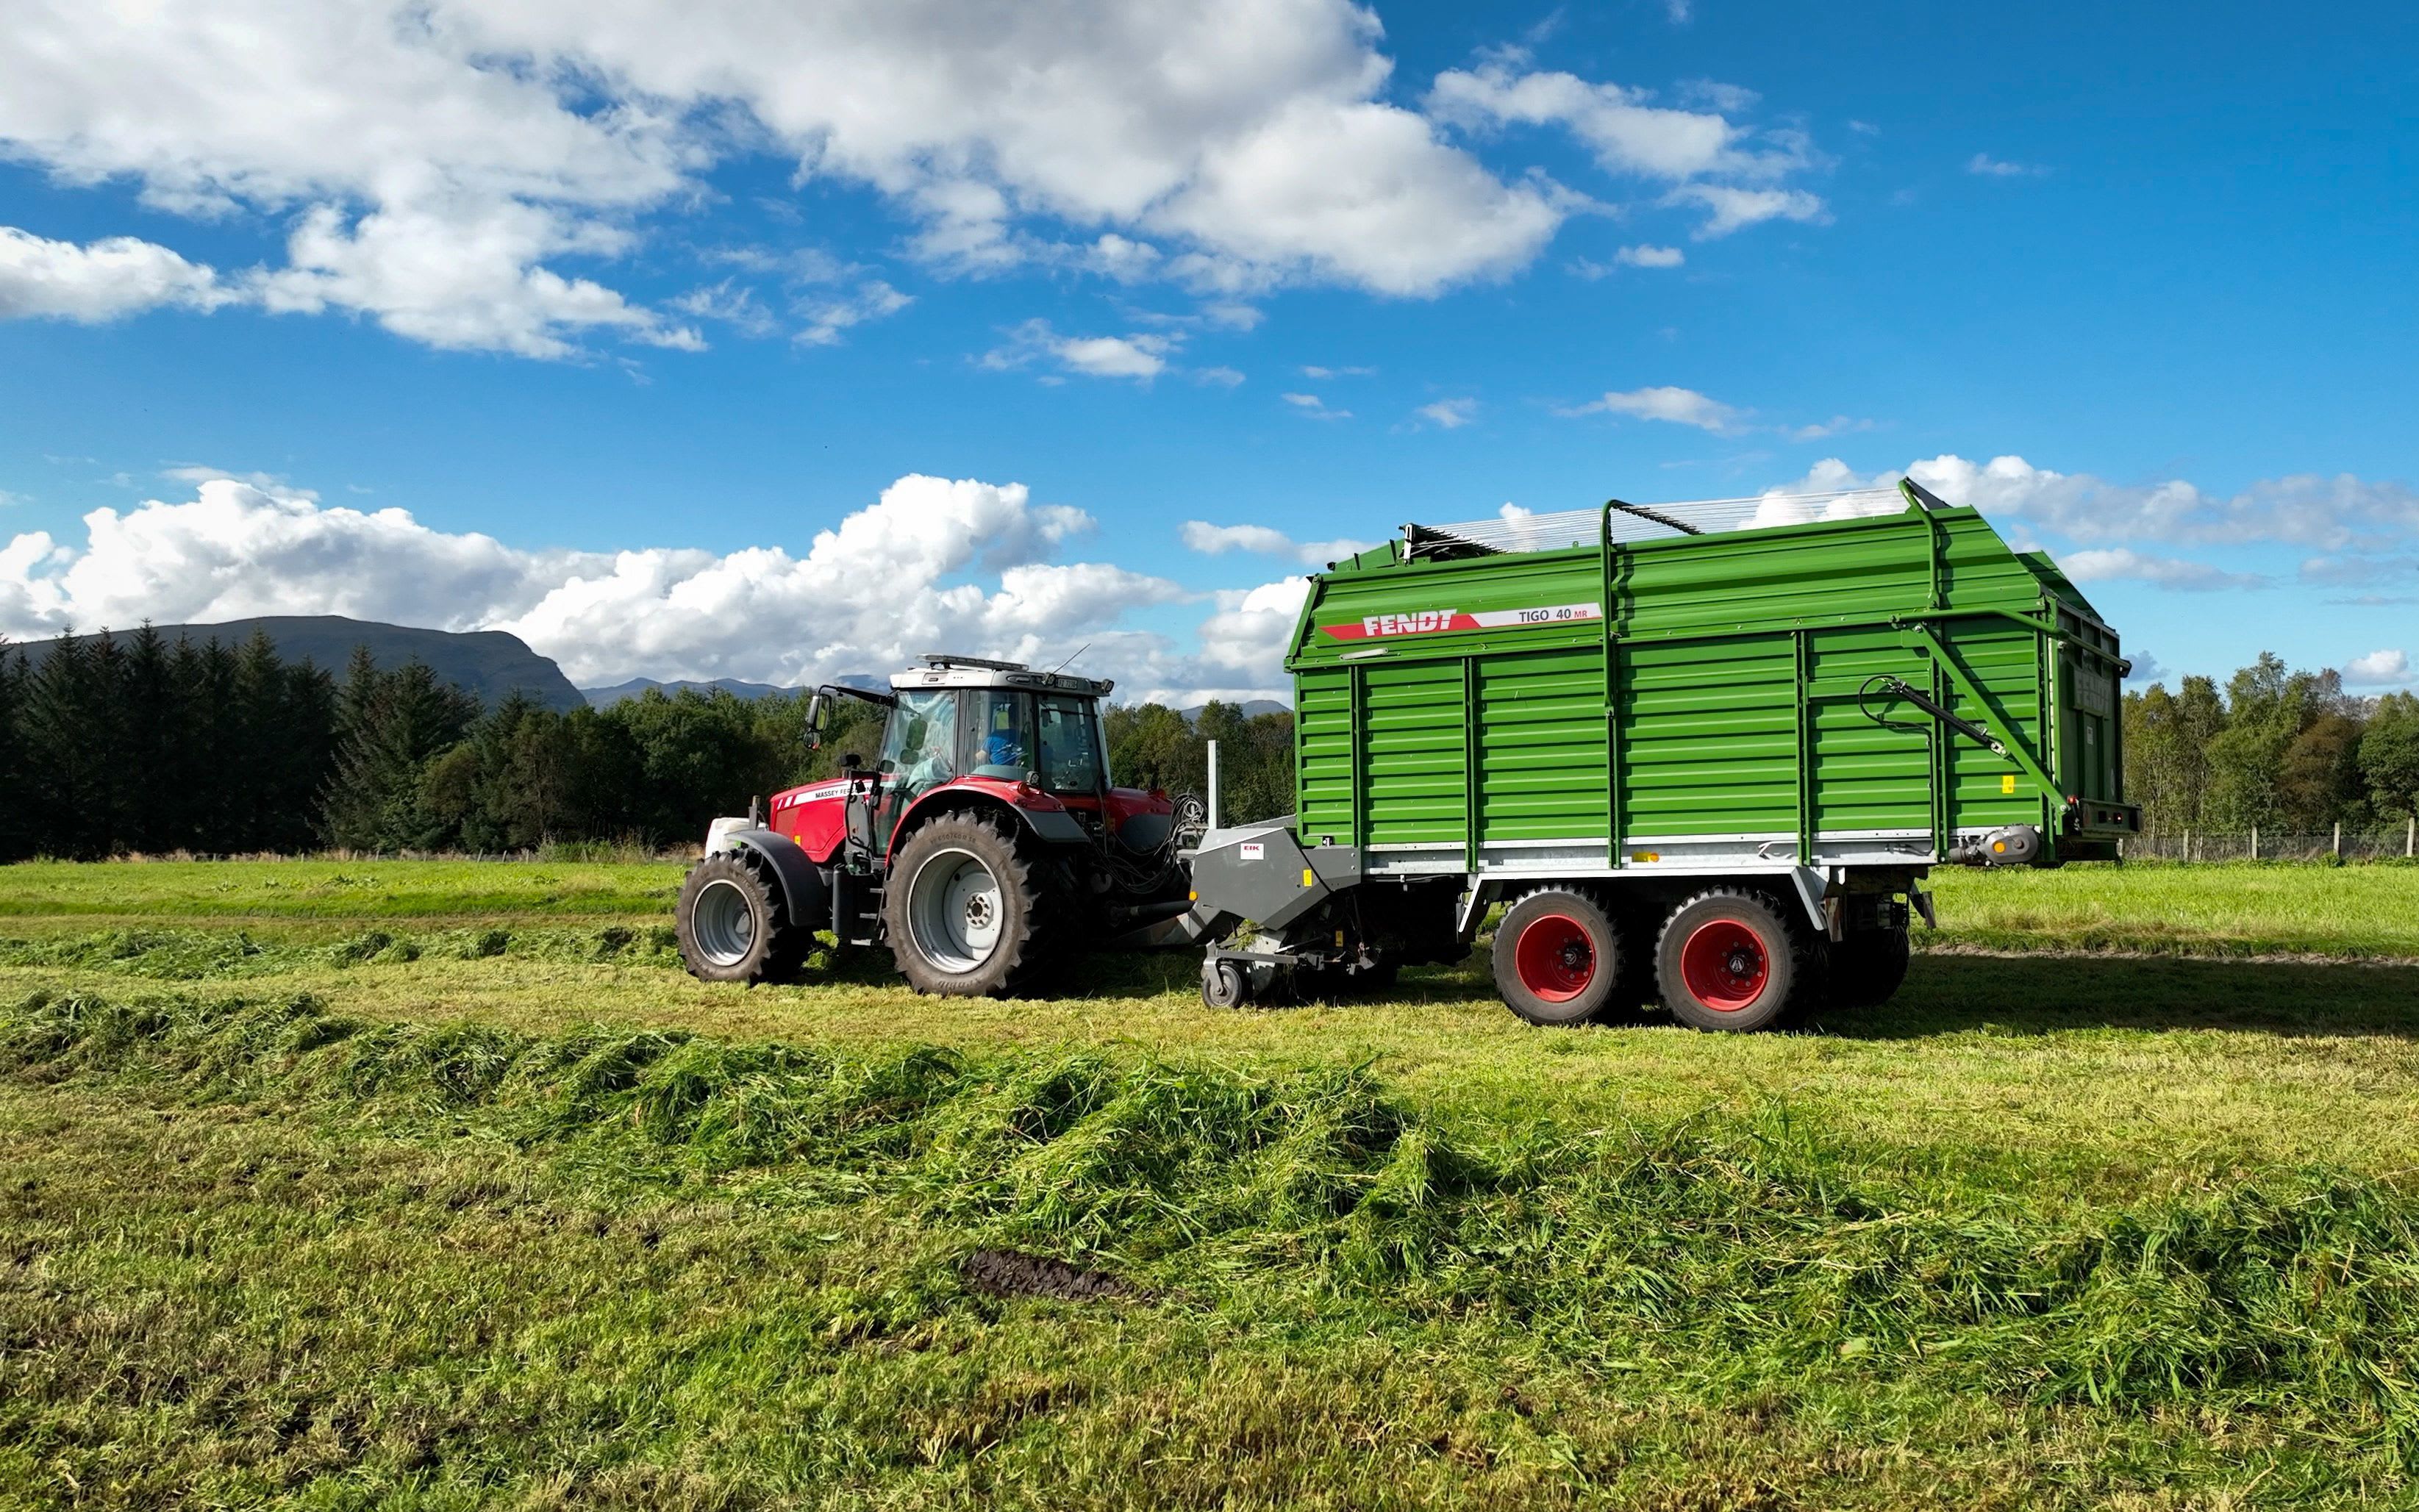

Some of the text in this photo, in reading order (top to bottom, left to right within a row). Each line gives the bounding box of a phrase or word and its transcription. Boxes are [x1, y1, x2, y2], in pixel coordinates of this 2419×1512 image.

[1363, 609, 1587, 637] FENDT TIGO 40 MR
[815, 789, 838, 798] MASSEY
